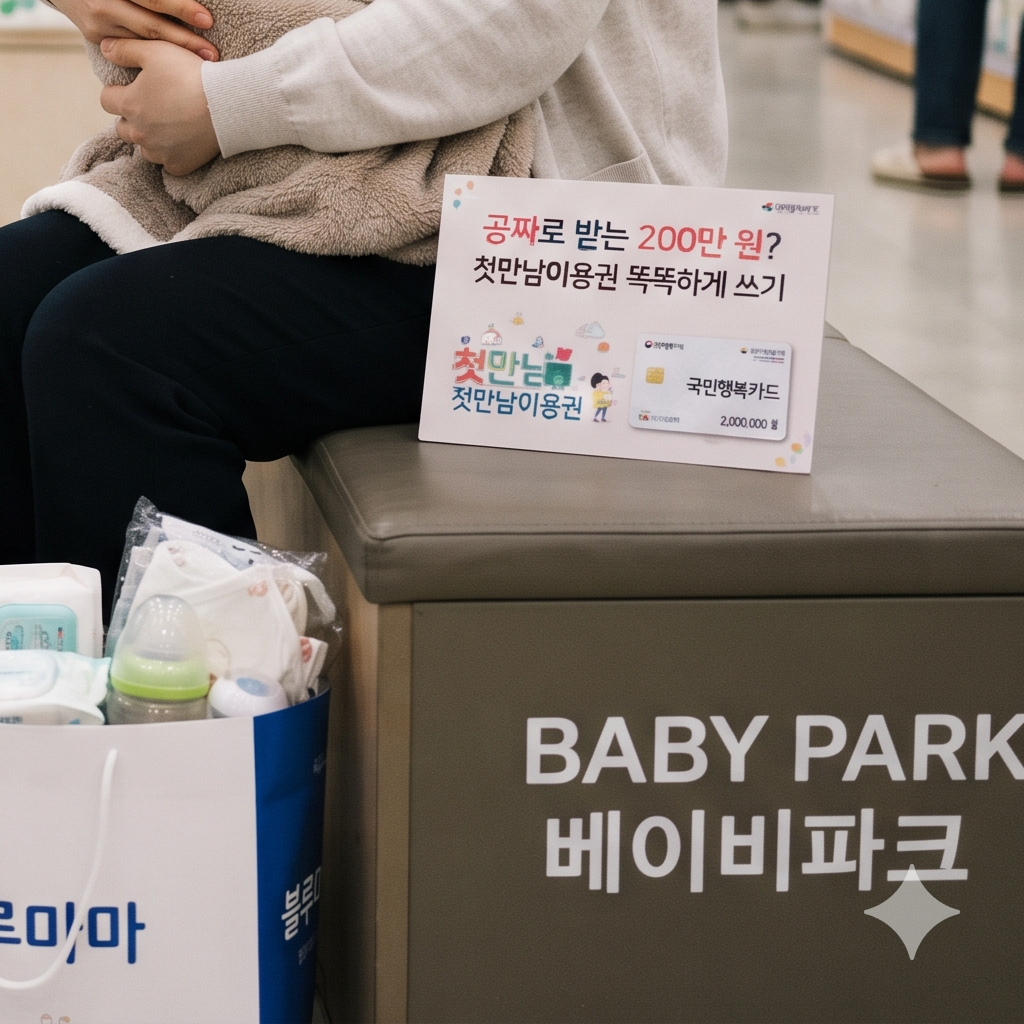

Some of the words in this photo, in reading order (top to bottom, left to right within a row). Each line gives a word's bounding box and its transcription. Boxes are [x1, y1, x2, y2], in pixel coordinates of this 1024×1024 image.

[483, 214, 565, 246] 공짜로
[575, 219, 629, 251] 받는
[637, 224, 728, 259] 200만
[734, 228, 782, 261] 원?
[473, 255, 619, 292] 첫만남이용권
[626, 264, 728, 299] 똑똑하게
[733, 273, 786, 303] 쓰기
[686, 377, 781, 401] 국민행복카드
[526, 715, 770, 785] BABY
[794, 713, 1024, 782] PARK
[545, 808, 969, 894] 베이비파크
